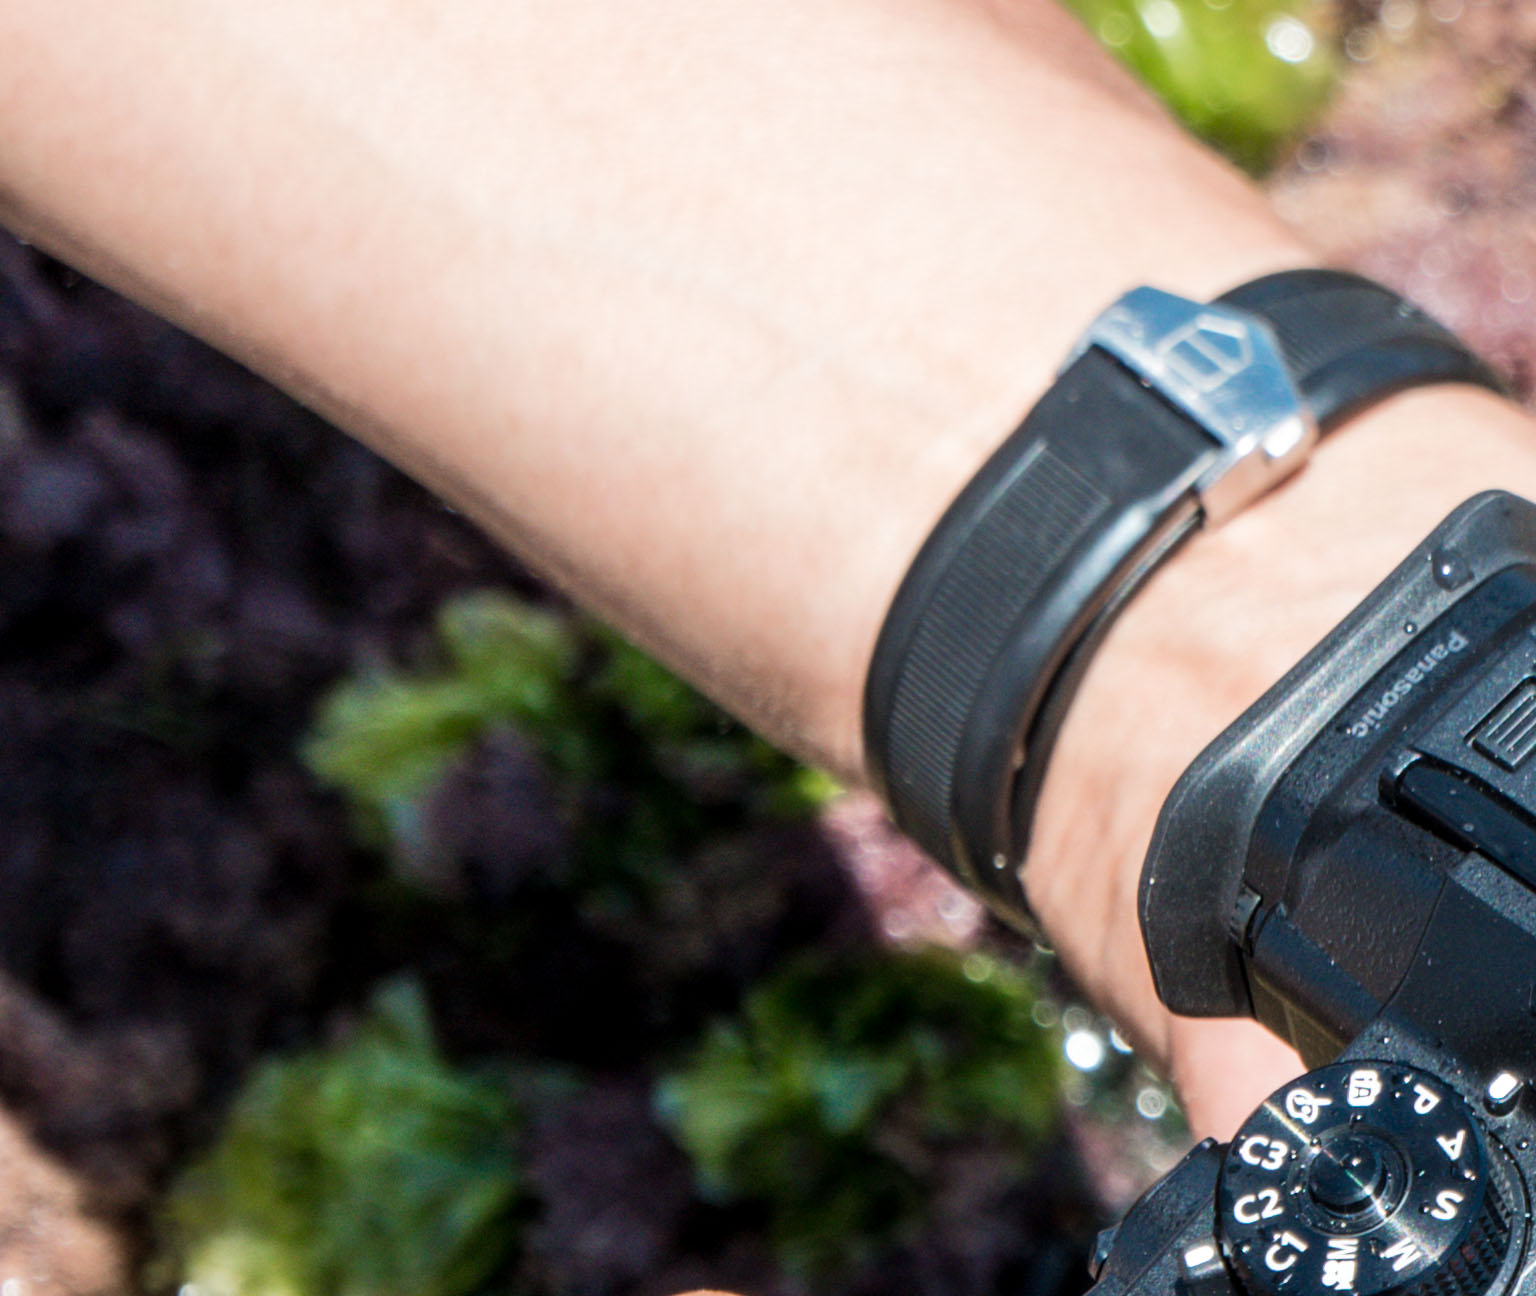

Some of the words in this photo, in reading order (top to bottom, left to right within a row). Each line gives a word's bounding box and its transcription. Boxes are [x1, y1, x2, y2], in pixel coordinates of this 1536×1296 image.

[1352, 631, 1469, 738] Panasonic
[1413, 1084, 1442, 1115] P
[1239, 1135, 1289, 1170] C3
[1436, 1129, 1466, 1161] A
[1233, 1189, 1284, 1224] C2
[1430, 1190, 1464, 1221] S
[1264, 1231, 1308, 1272] C1
[1385, 1236, 1422, 1272] M
